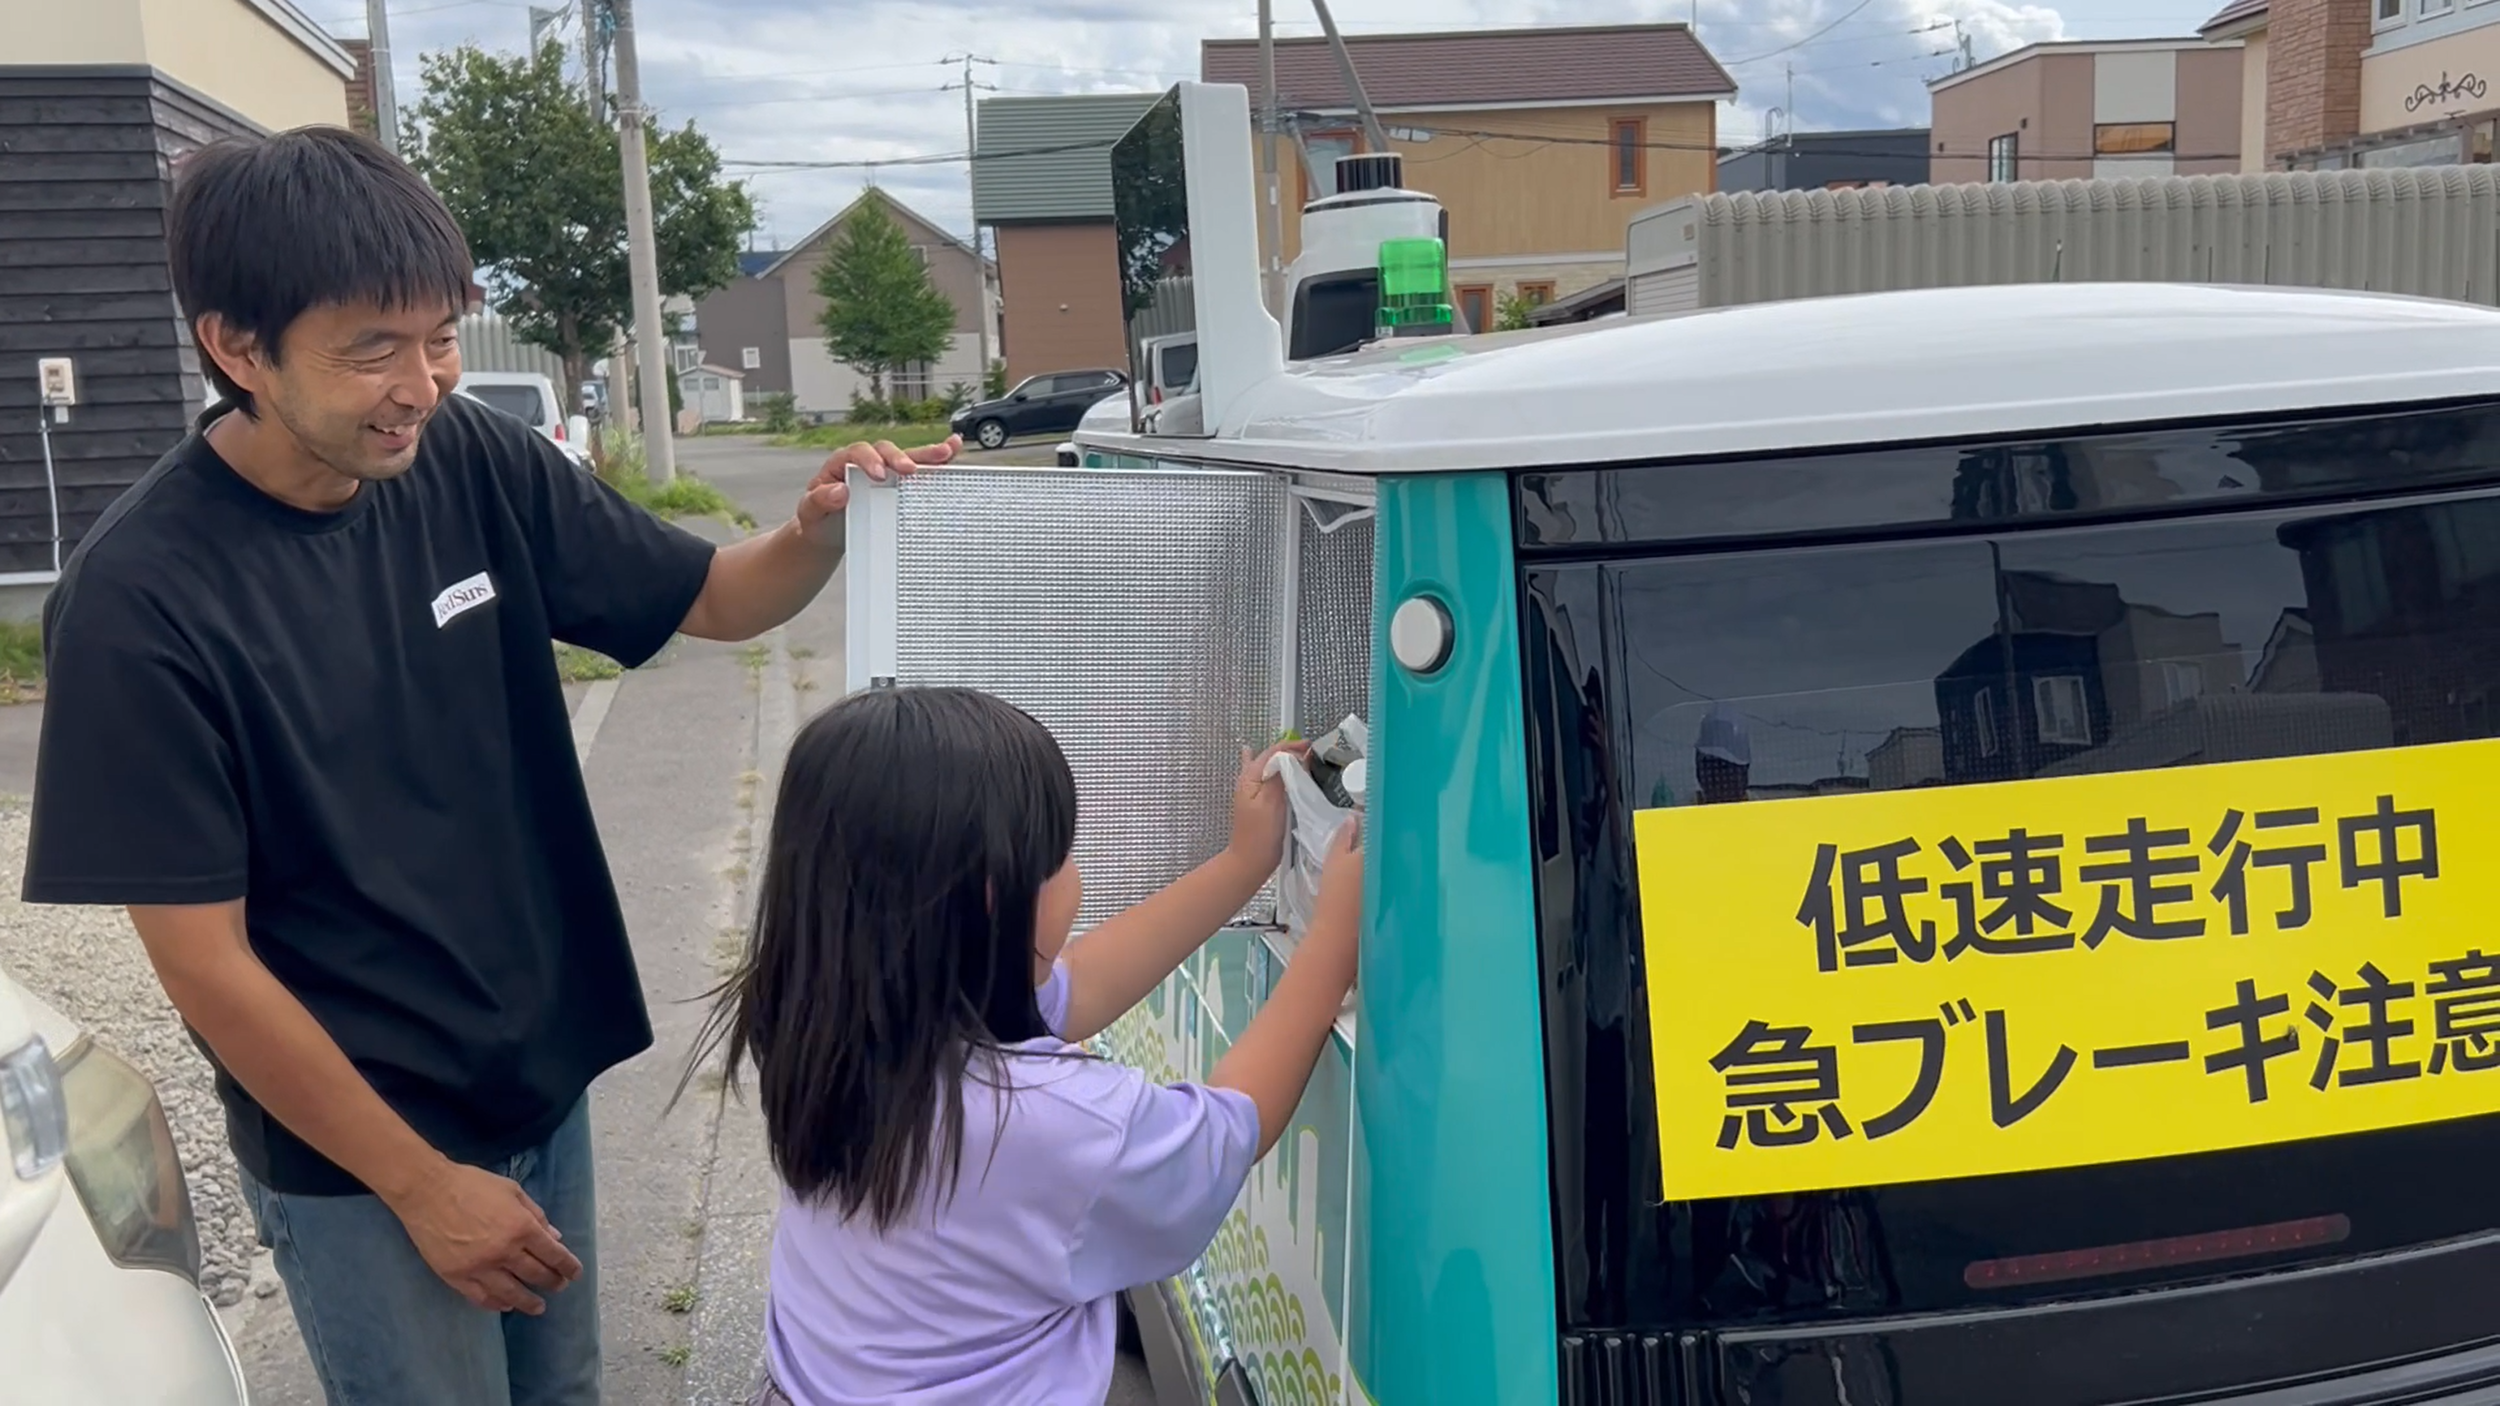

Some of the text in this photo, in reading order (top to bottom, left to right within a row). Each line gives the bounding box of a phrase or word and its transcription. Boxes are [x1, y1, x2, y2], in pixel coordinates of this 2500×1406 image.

[1795, 794, 2440, 973] 低速走行中
[1708, 949, 2500, 1150] 急ブレーキ注意
